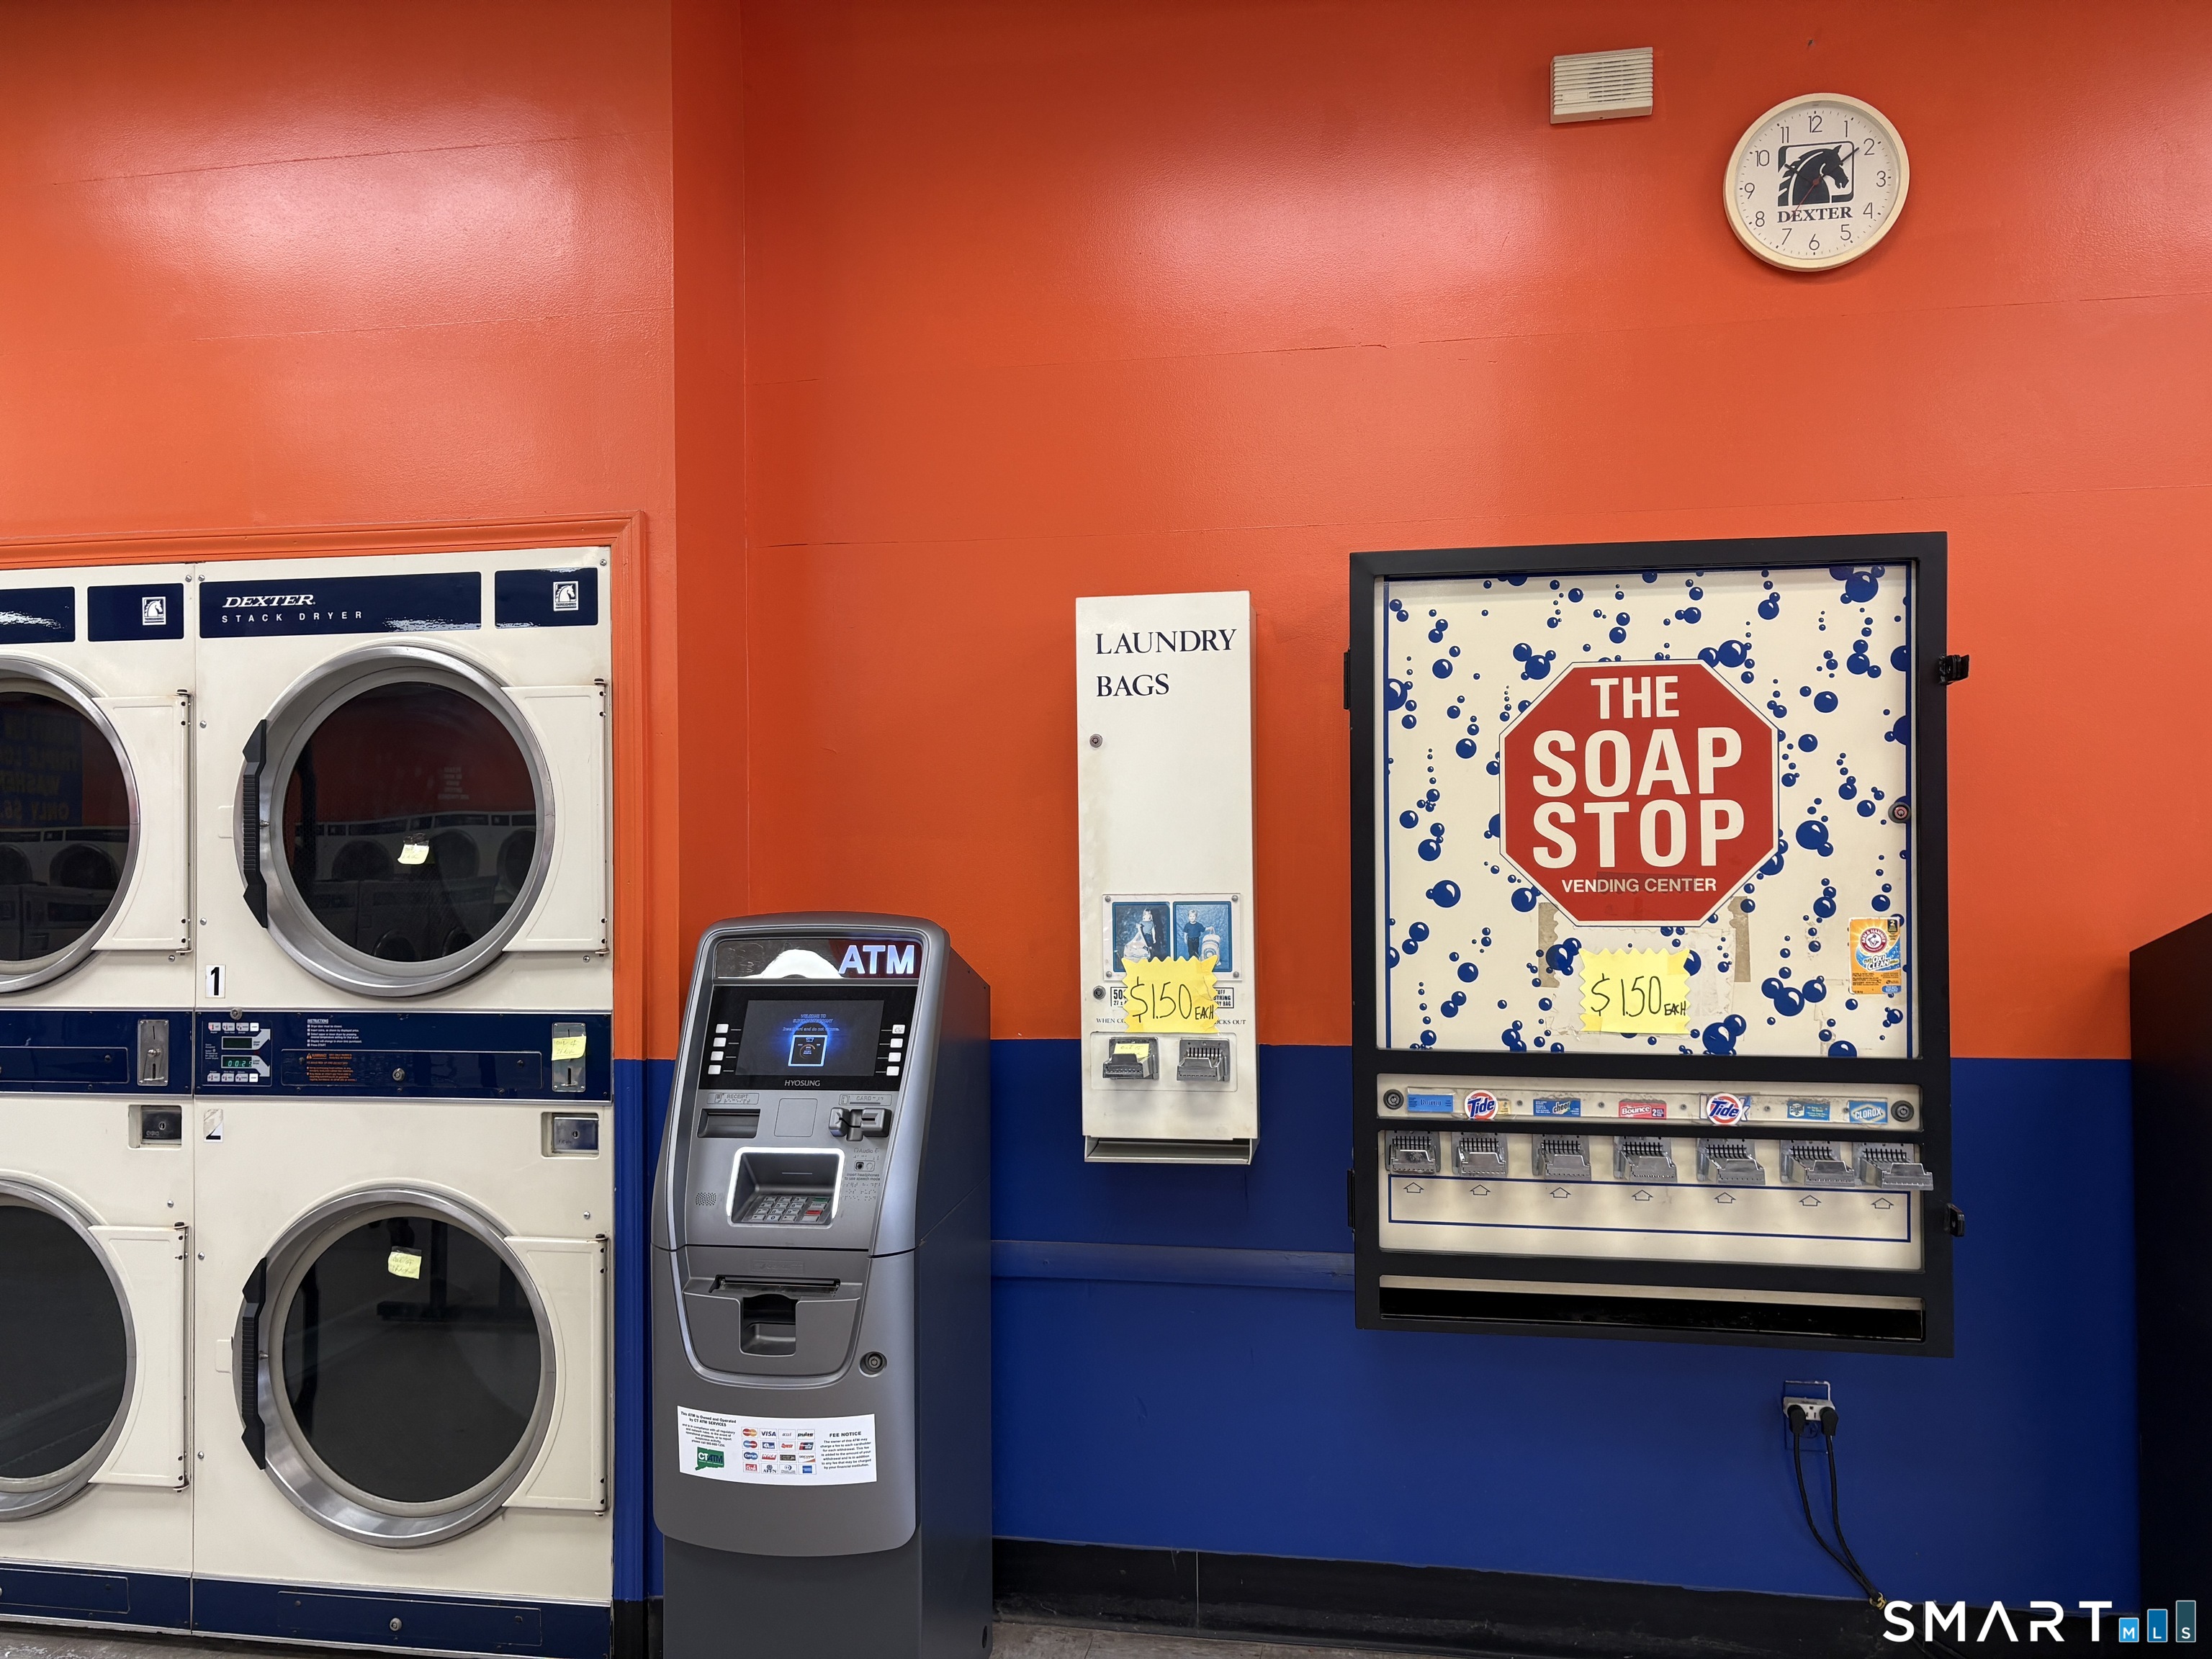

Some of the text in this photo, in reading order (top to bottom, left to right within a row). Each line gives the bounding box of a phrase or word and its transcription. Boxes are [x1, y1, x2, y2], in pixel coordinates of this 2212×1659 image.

[1809, 115, 1822, 132] 12
[1844, 120, 1848, 138] 1
[1781, 127, 1789, 143] 11
[1863, 138, 1874, 156] 2
[1755, 150, 1770, 166] 10
[1876, 171, 1886, 187] 3
[1744, 182, 1755, 199] 9
[1755, 211, 1765, 227] 8
[1777, 206, 1853, 222] DEXTER
[1863, 202, 1873, 219] 4
[1782, 228, 1792, 245] 7
[1840, 224, 1851, 240] 5
[1809, 233, 1820, 250] 6
[222, 594, 315, 608] DEXTER
[222, 611, 361, 623] STACK DRYER
[1096, 629, 1237, 655] LAUNDRY
[1097, 673, 1169, 696] BAGS
[1591, 675, 1680, 719] THE
[1532, 726, 1742, 797] SOAP
[1532, 799, 1745, 868] STOP
[1562, 877, 1717, 893] VENDING CENTER
[838, 945, 914, 974] ATM
[1867, 958, 1890, 970] CLEAN
[210, 967, 220, 996] 1
[1195, 1004, 1214, 1020] EACH
[1665, 1001, 1686, 1016] EACH
[1467, 1097, 1496, 1118] Tide
[1552, 1101, 1570, 1113] cheer
[1622, 1105, 1651, 1115] Bounce
[1709, 1100, 1740, 1118] Tide
[1855, 1107, 1882, 1119] CLOROX
